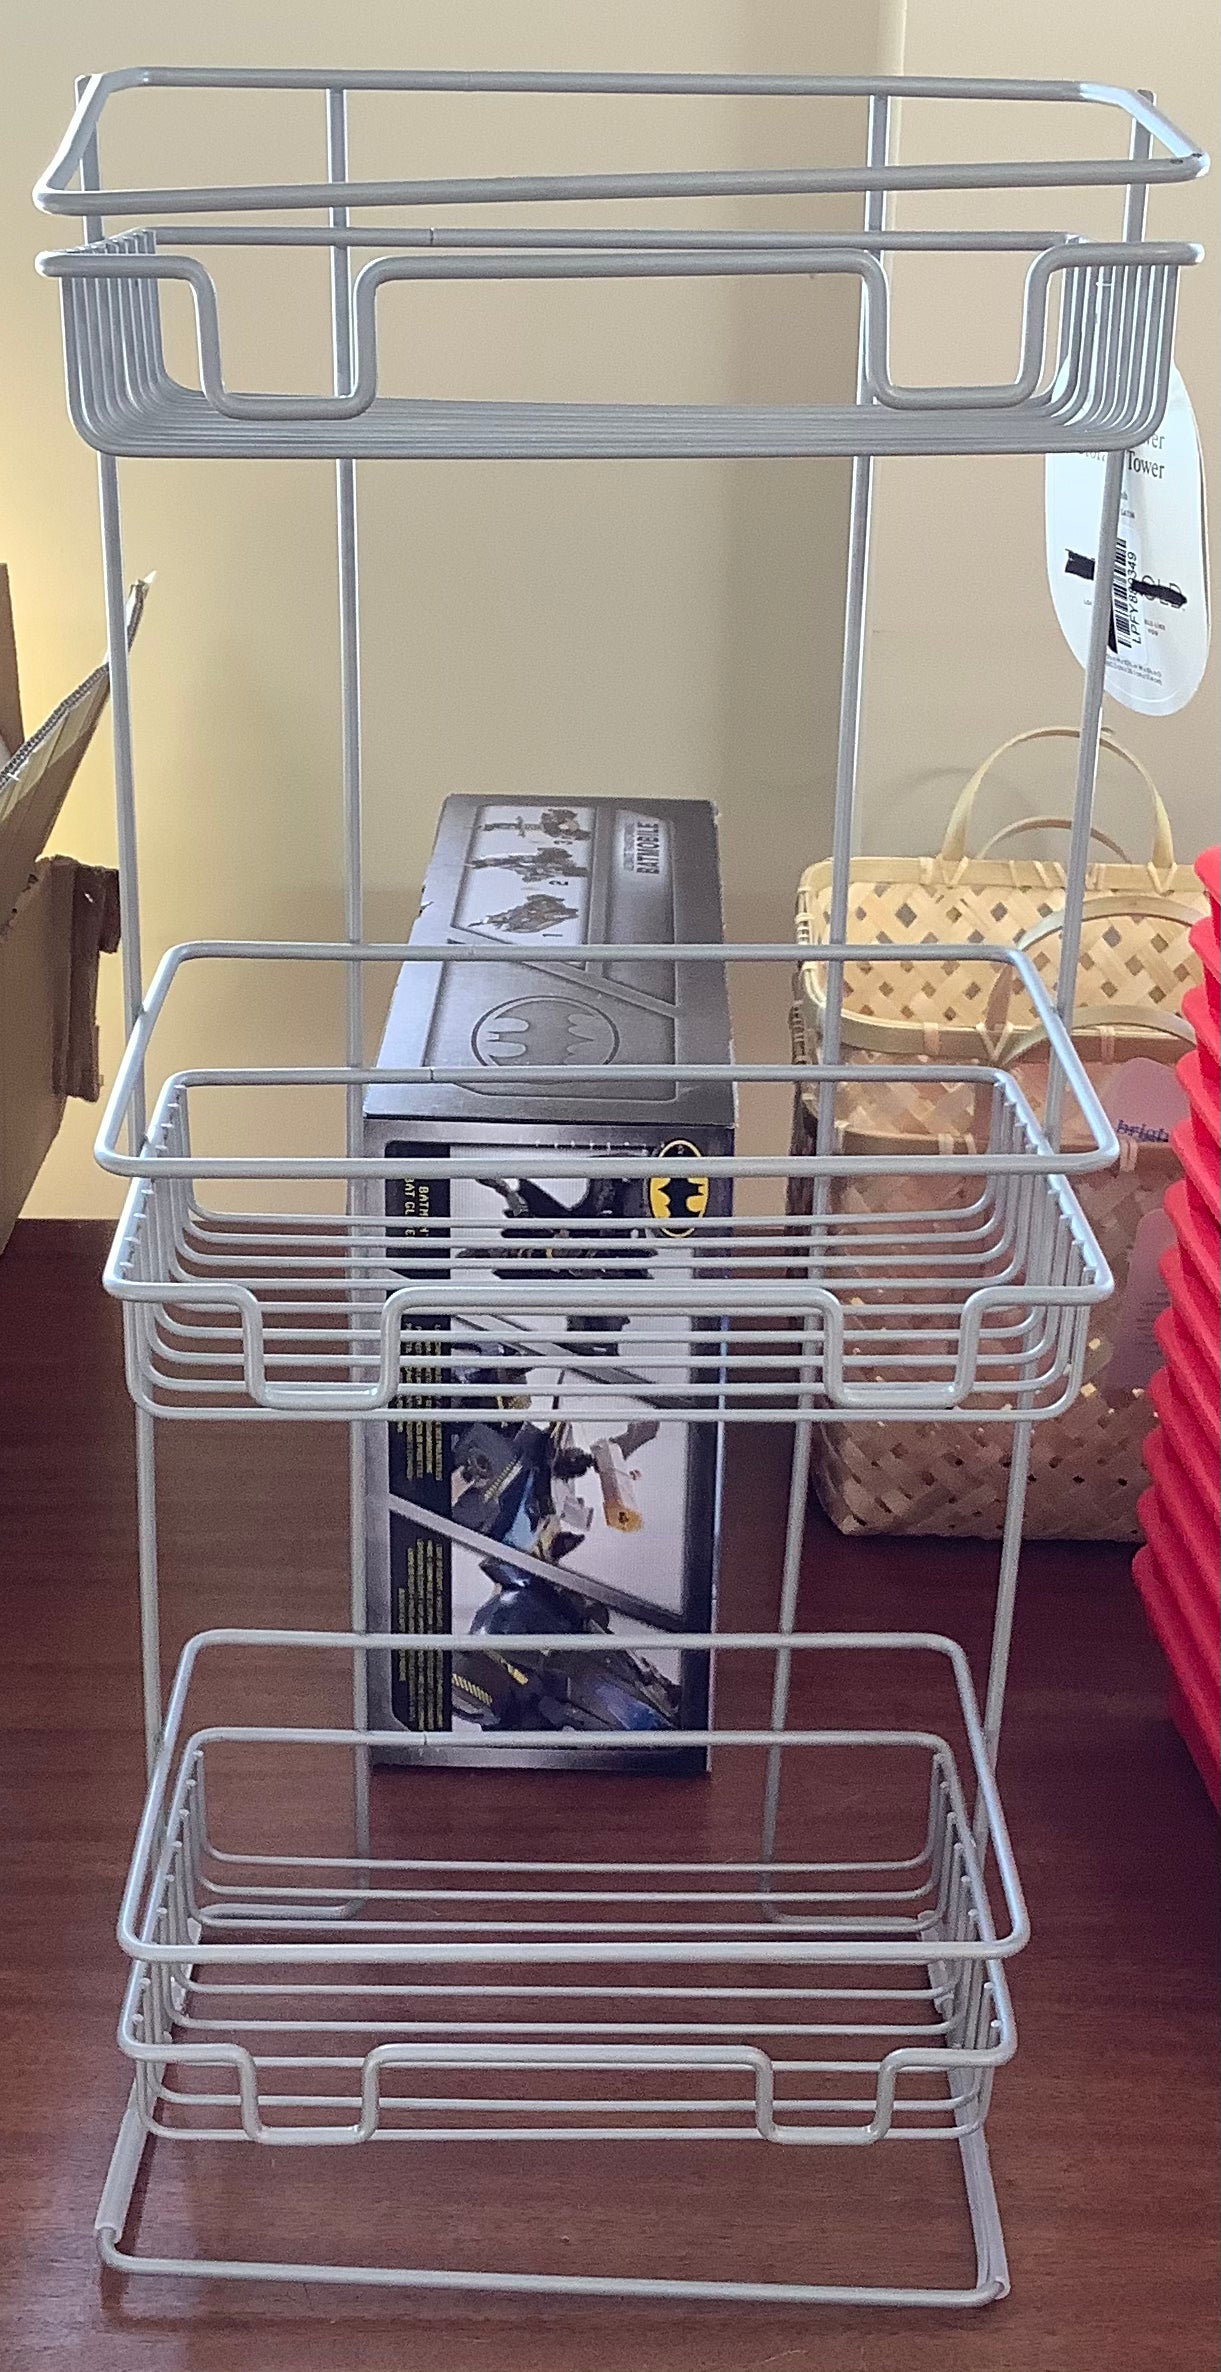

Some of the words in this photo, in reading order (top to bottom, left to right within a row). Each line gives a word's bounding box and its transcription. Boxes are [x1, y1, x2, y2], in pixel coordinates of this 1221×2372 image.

[1126, 450, 1165, 479] Tower
[636, 822, 660, 875] BATMOBILE
[1116, 1119, 1169, 1143] brigh
